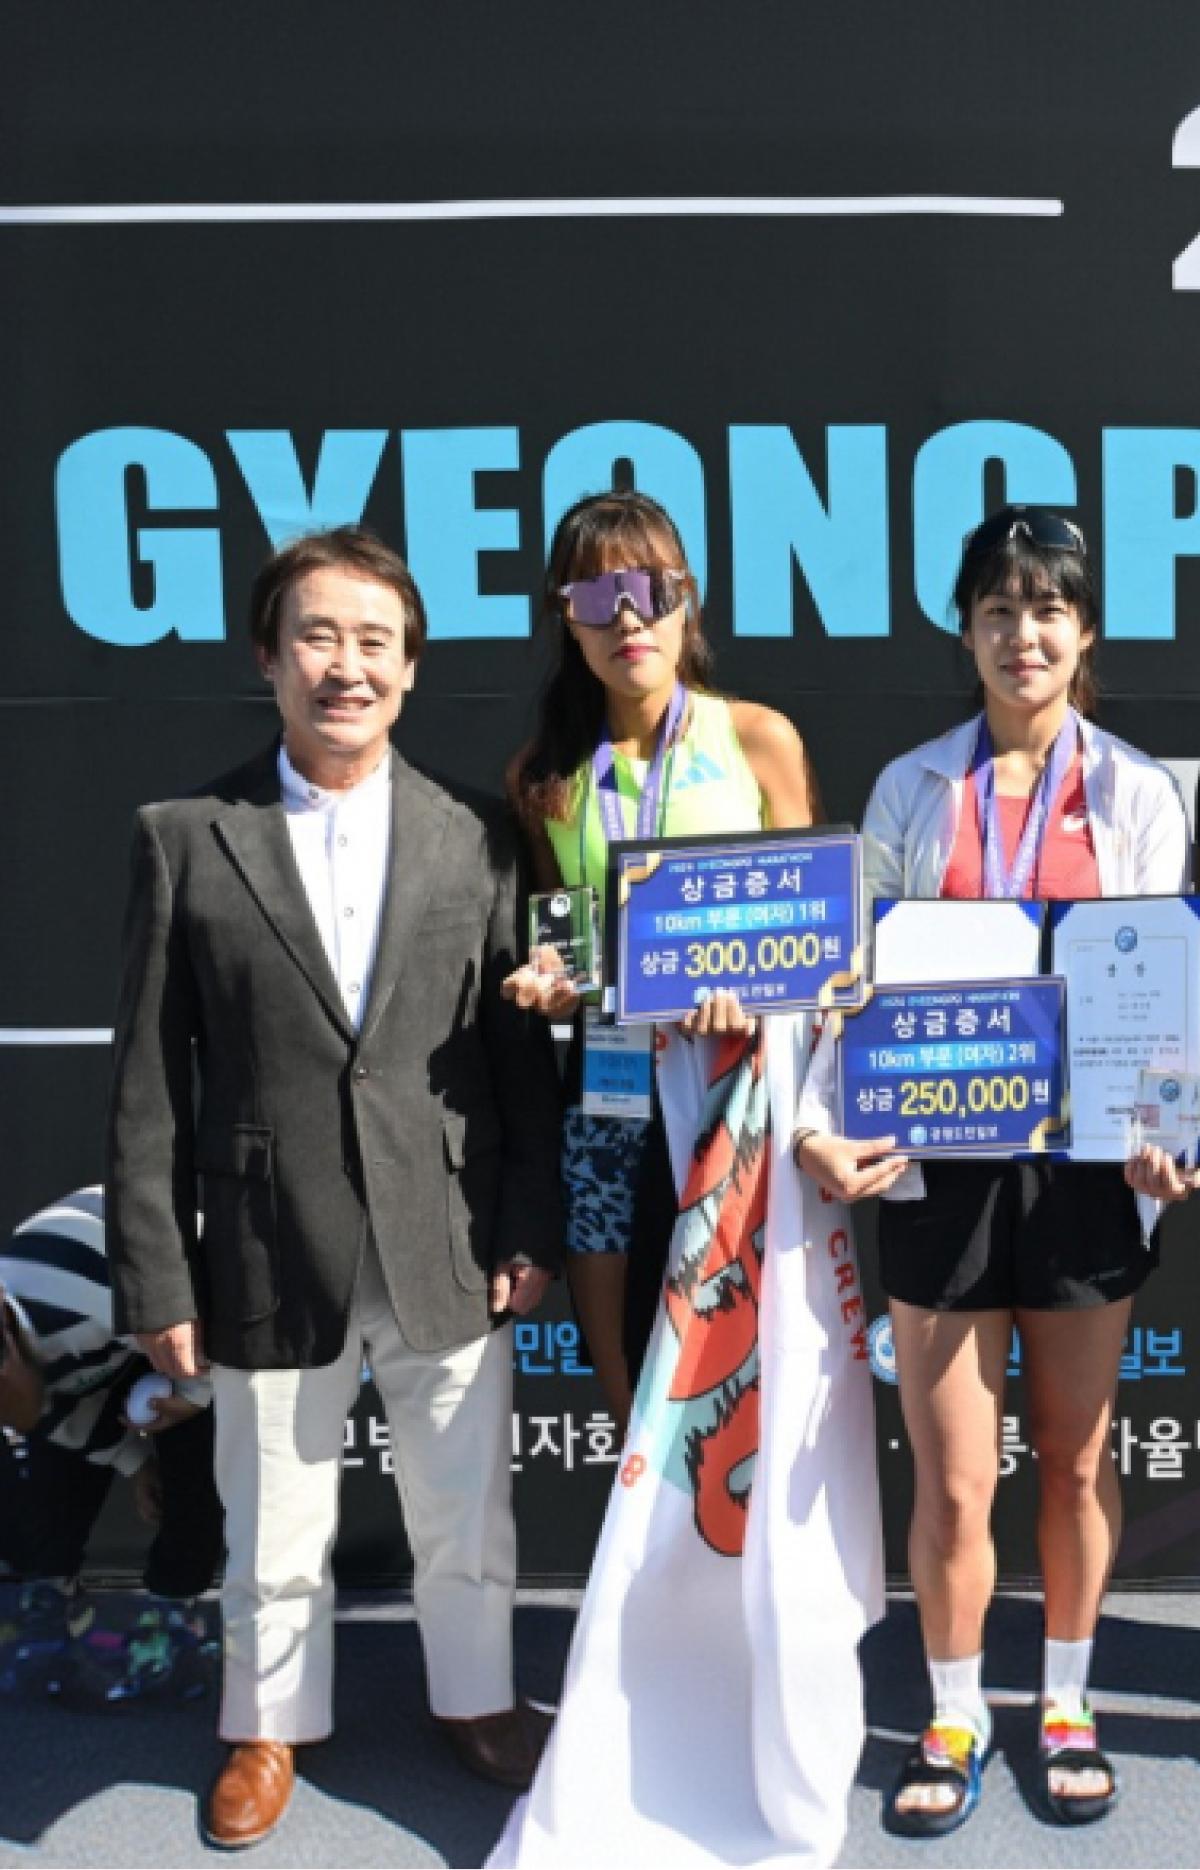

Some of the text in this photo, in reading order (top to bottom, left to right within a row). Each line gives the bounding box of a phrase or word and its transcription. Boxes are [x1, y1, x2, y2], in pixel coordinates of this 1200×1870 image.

[655, 914, 702, 933] 10km
[799, 900, 826, 922] 1위
[640, 949, 679, 977] 상금
[869, 1050, 915, 1070] 10km
[1009, 1041, 1036, 1064] 2위
[857, 1087, 895, 1112] 상금
[827, 1228, 870, 1361] CREW
